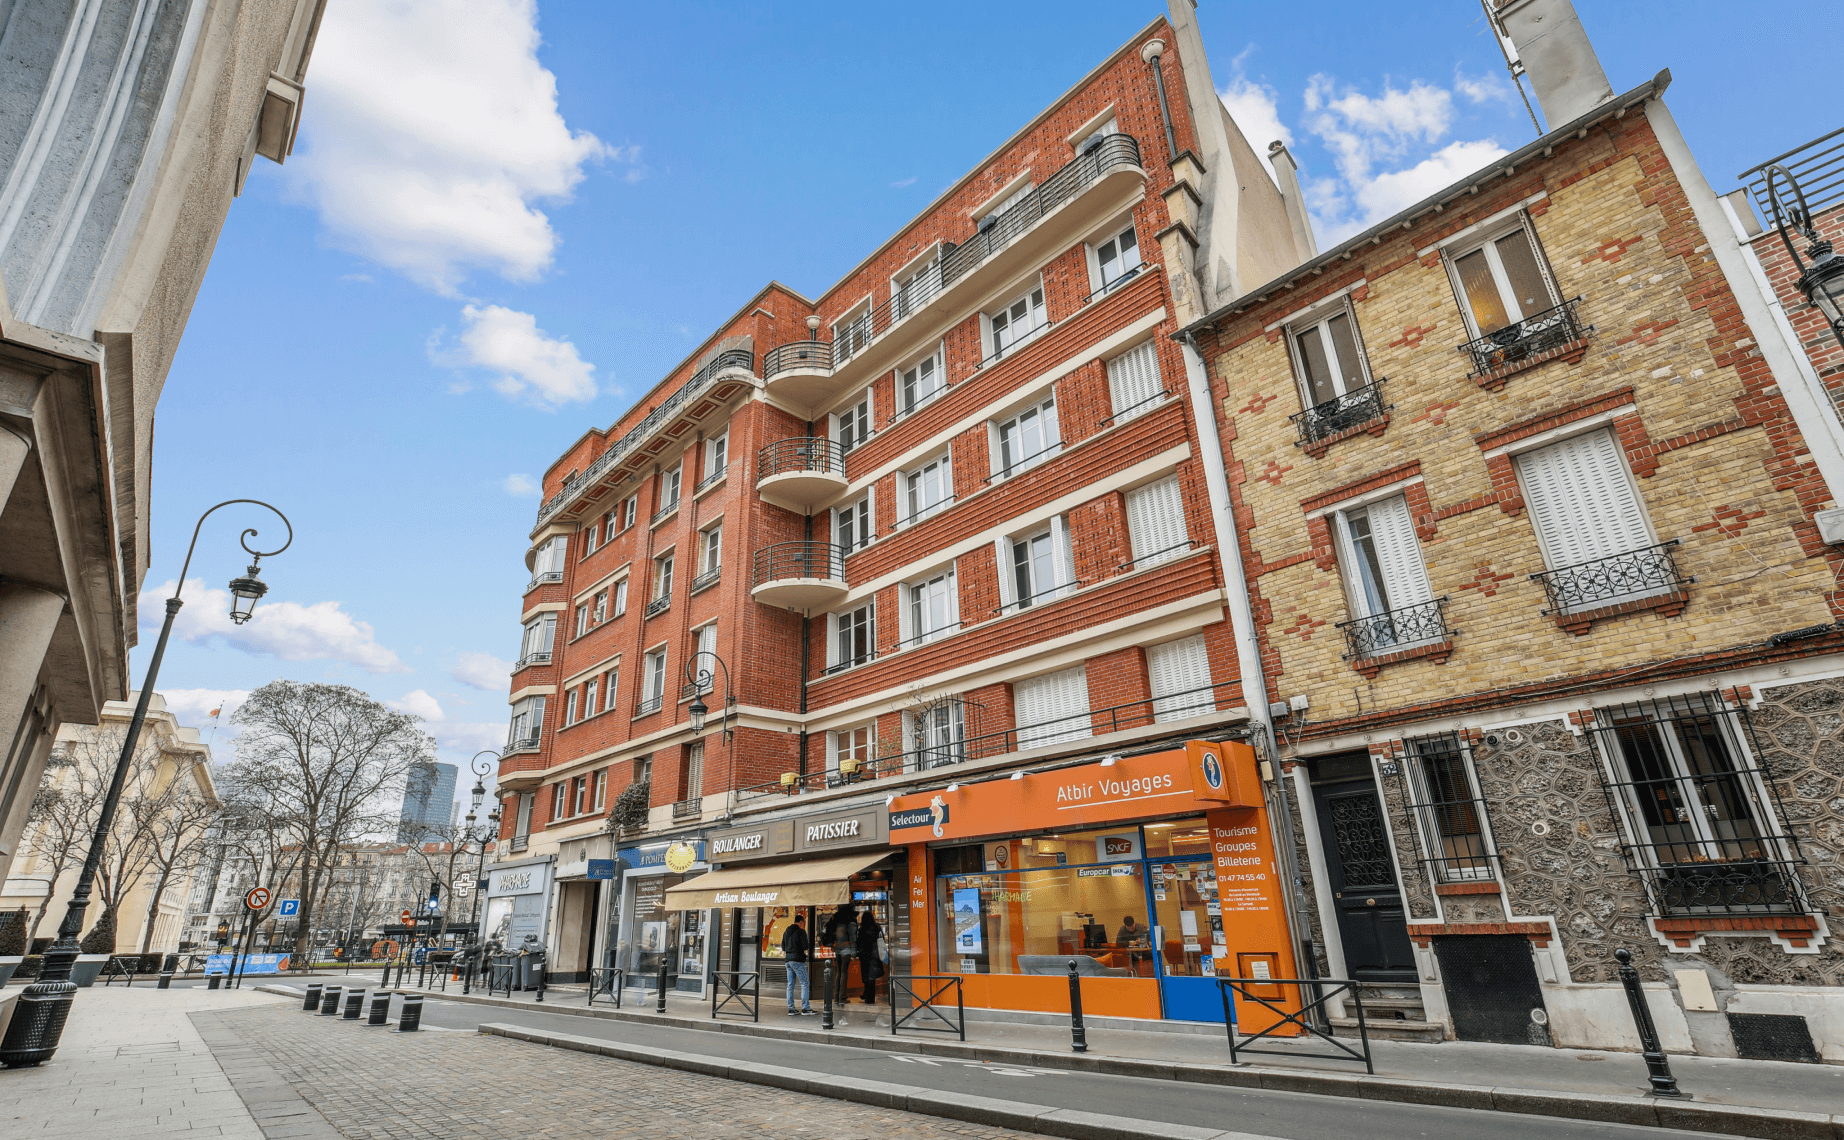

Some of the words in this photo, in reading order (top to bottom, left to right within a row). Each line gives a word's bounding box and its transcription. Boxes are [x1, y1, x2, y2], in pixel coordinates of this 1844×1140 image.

[1057, 783, 1093, 802] Atbir
[1098, 774, 1172, 796] Voyages
[891, 813, 930, 827] Selectour
[806, 819, 859, 842] PATISSIER
[1213, 826, 1258, 838] Tourisme
[712, 834, 762, 854] BOULANGER
[1107, 842, 1131, 853] SNCF
[1215, 842, 1257, 853] Groupes
[1217, 856, 1261, 867] Billeterie
[1078, 868, 1110, 878] Europcar
[1245, 873, 1255, 881] 55
[913, 875, 922, 884] Air
[913, 887, 924, 896] Fer
[714, 891, 739, 904] Artisan
[740, 891, 778, 904] Boulanger
[284, 902, 295, 914] P
[912, 900, 925, 908] Mer
